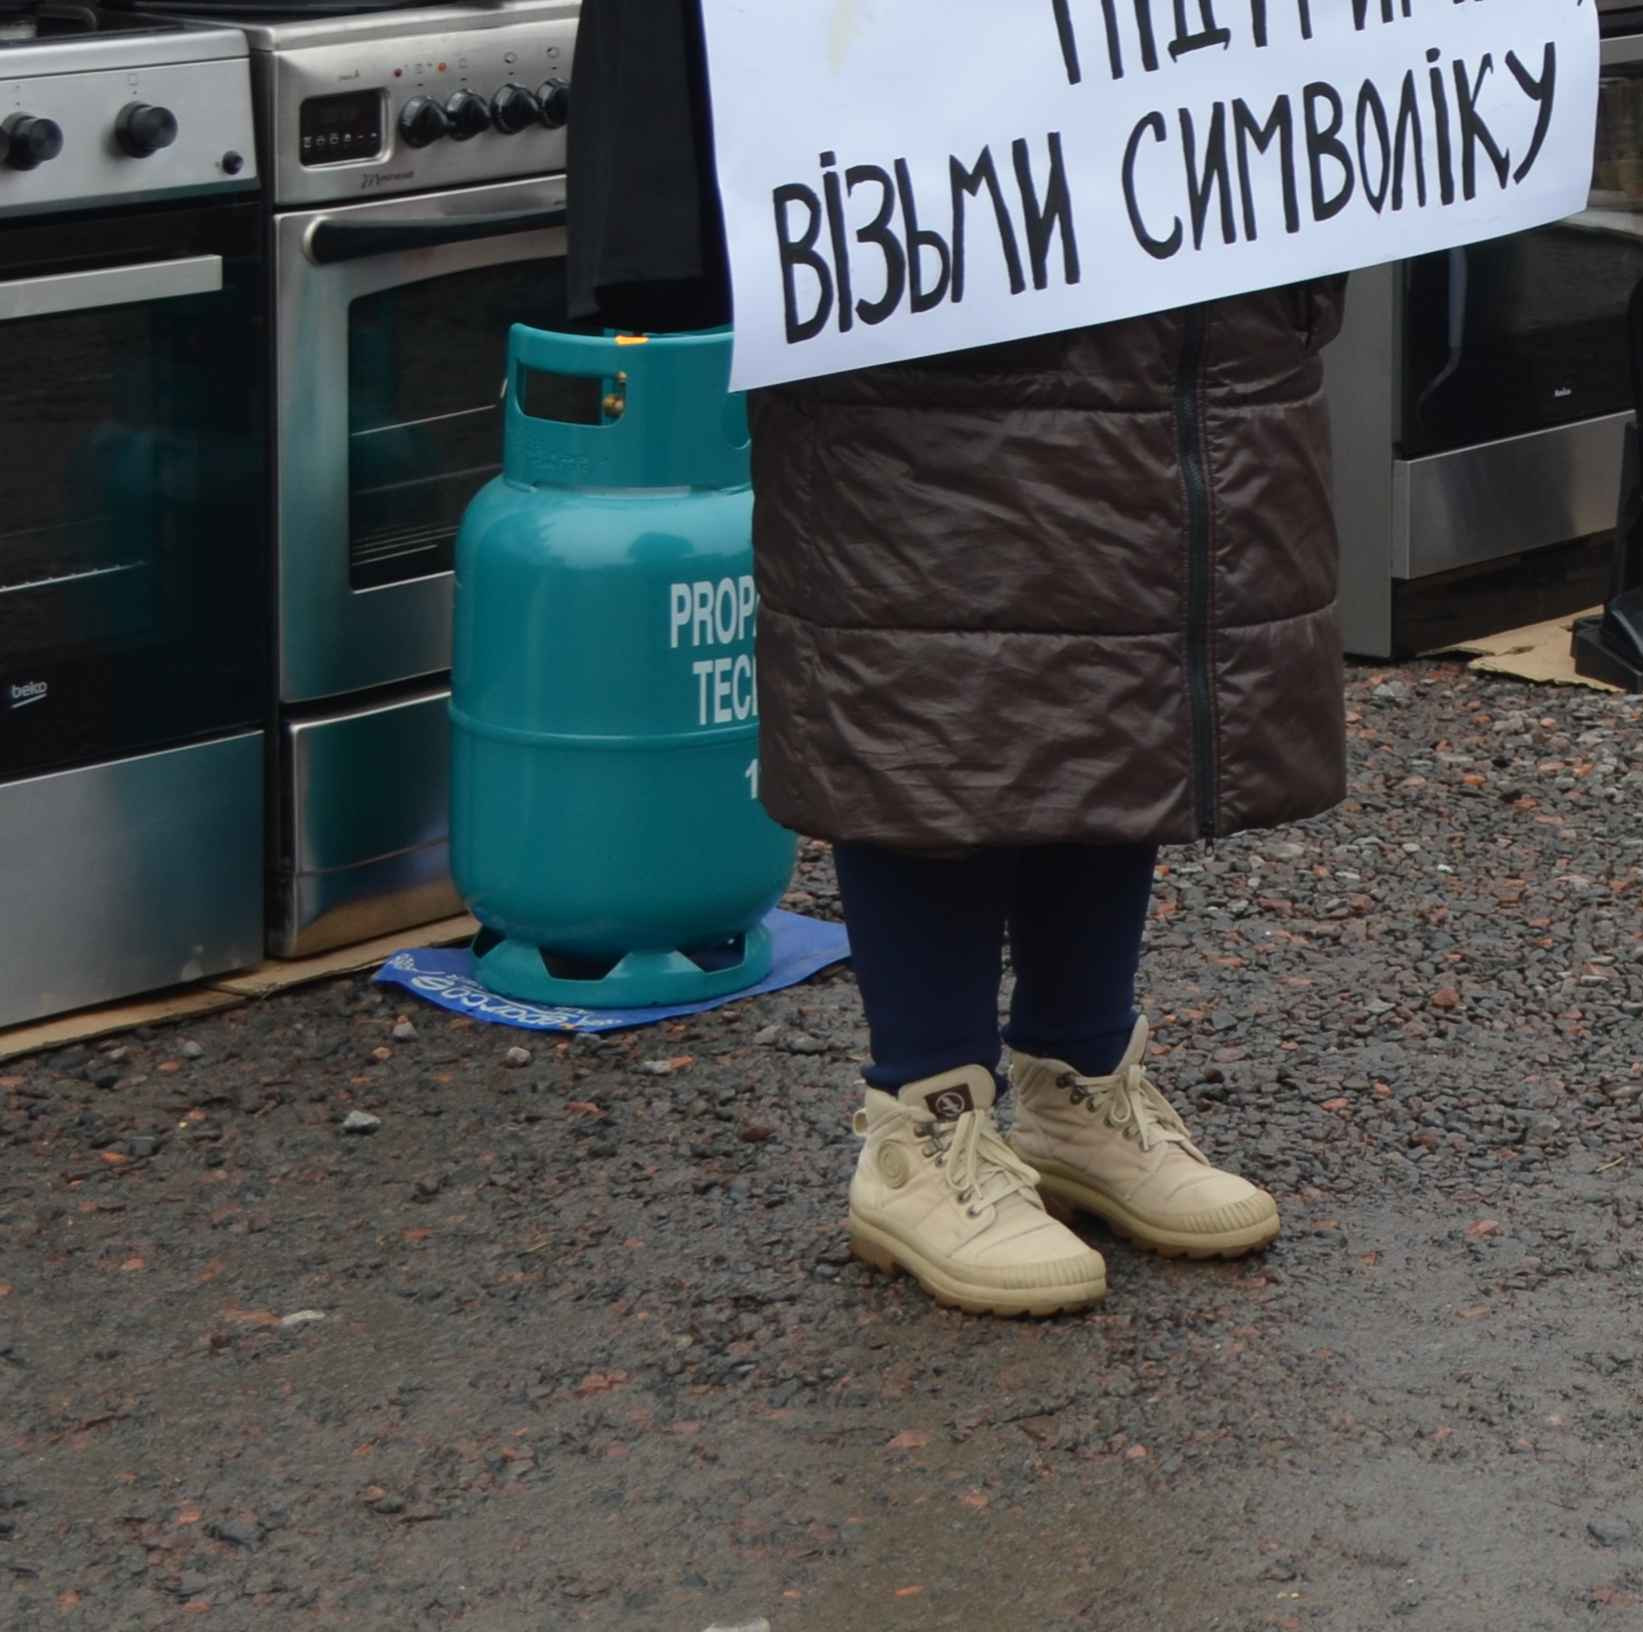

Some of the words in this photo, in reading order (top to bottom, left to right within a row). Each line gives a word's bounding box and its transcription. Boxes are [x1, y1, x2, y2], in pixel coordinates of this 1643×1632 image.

[770, 130, 1082, 345] ВІЗЬМИ
[1120, 40, 1559, 262] СИМВОЛІКУ
[11, 681, 48, 698] beko
